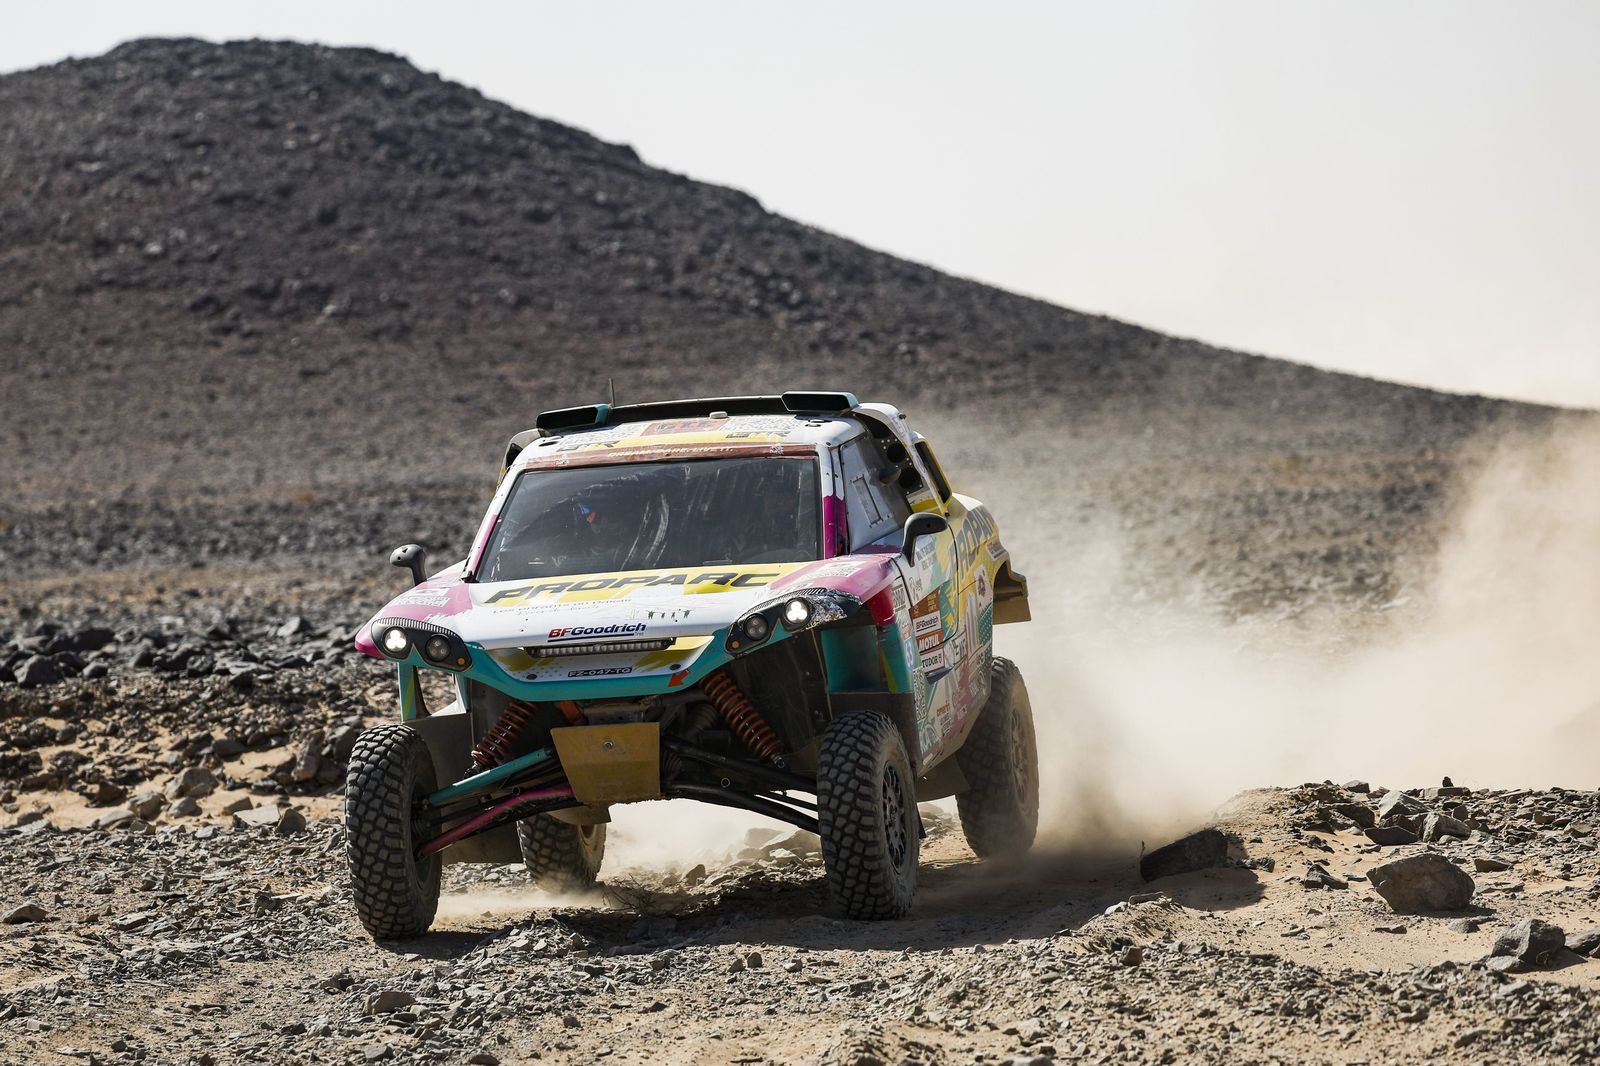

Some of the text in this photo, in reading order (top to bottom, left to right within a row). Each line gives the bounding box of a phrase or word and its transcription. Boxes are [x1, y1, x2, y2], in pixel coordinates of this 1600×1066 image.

[485, 573, 779, 603] PROPARC
[548, 623, 646, 638] BFGoodrich
[919, 633, 940, 651] MOTUL
[921, 655, 939, 668] TUDOR
